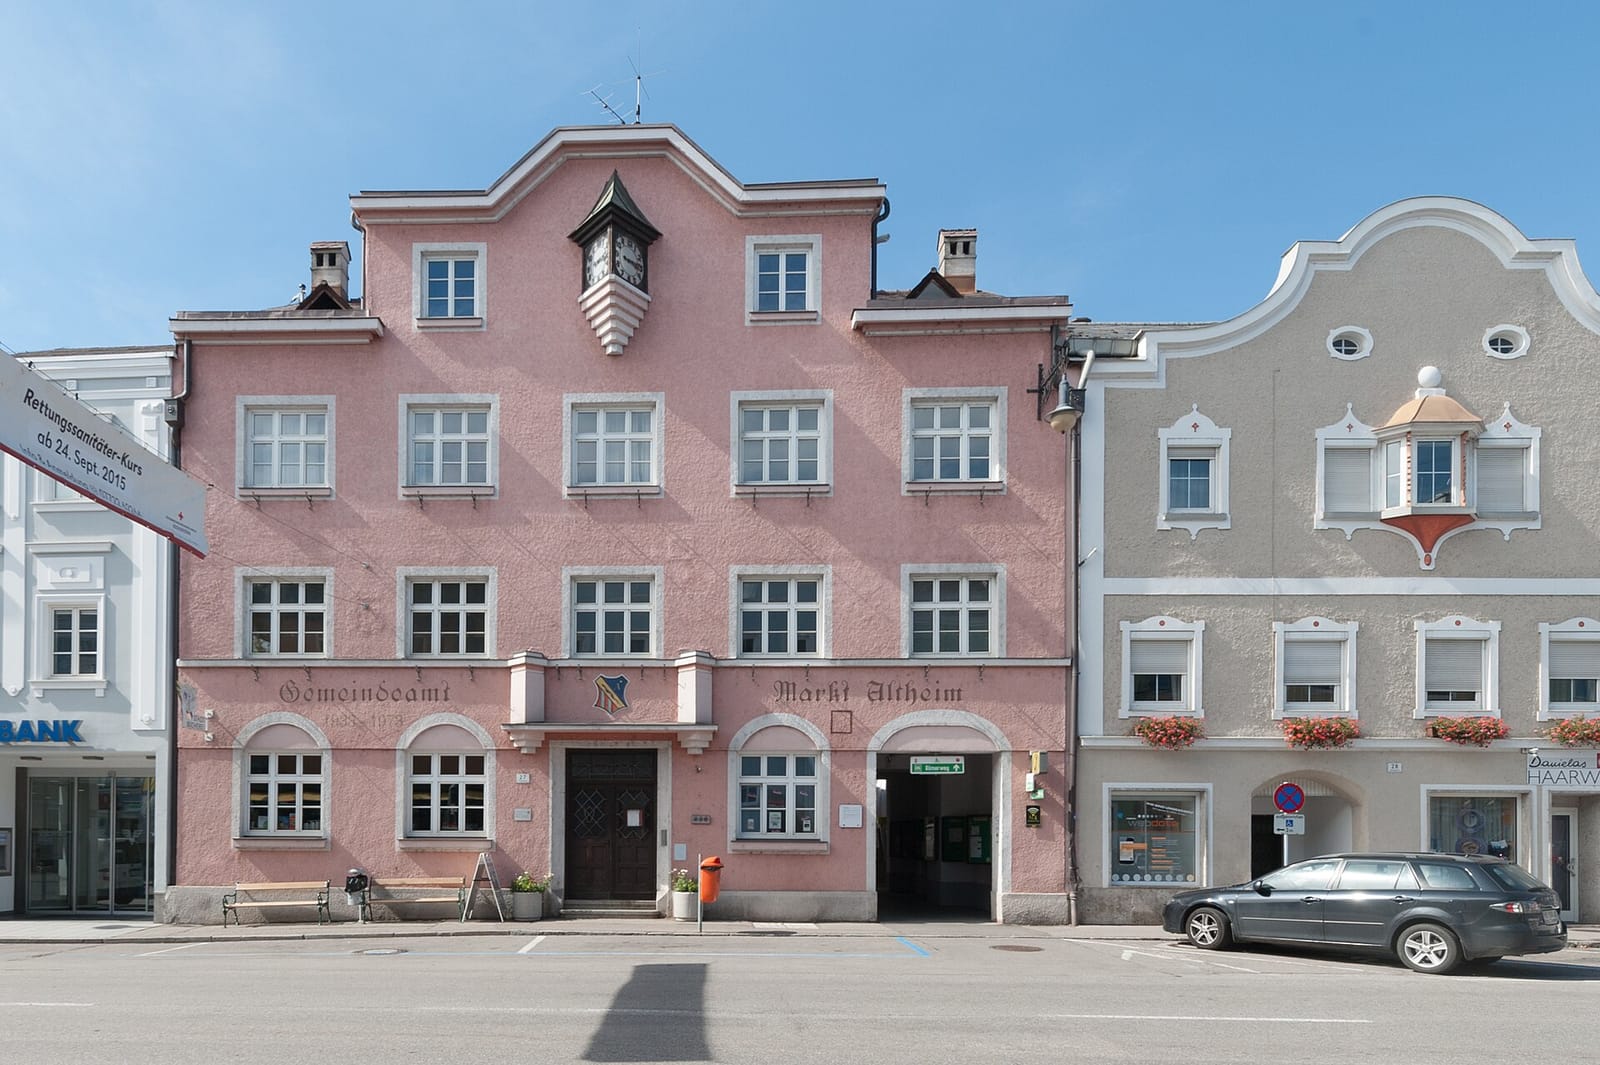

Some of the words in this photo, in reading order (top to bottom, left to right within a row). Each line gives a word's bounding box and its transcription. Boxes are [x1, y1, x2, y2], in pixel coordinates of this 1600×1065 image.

[23, 388, 143, 476] Rettungssanitäter-Kurs
[37, 431, 52, 449] ab
[55, 438, 72, 461] 24.
[74, 450, 100, 476] Sept.
[102, 466, 126, 491] 2015
[279, 679, 451, 703] Gemeindeamt
[773, 679, 850, 705] Markt
[867, 679, 963, 706] Altheim
[0, 720, 83, 742] BANK
